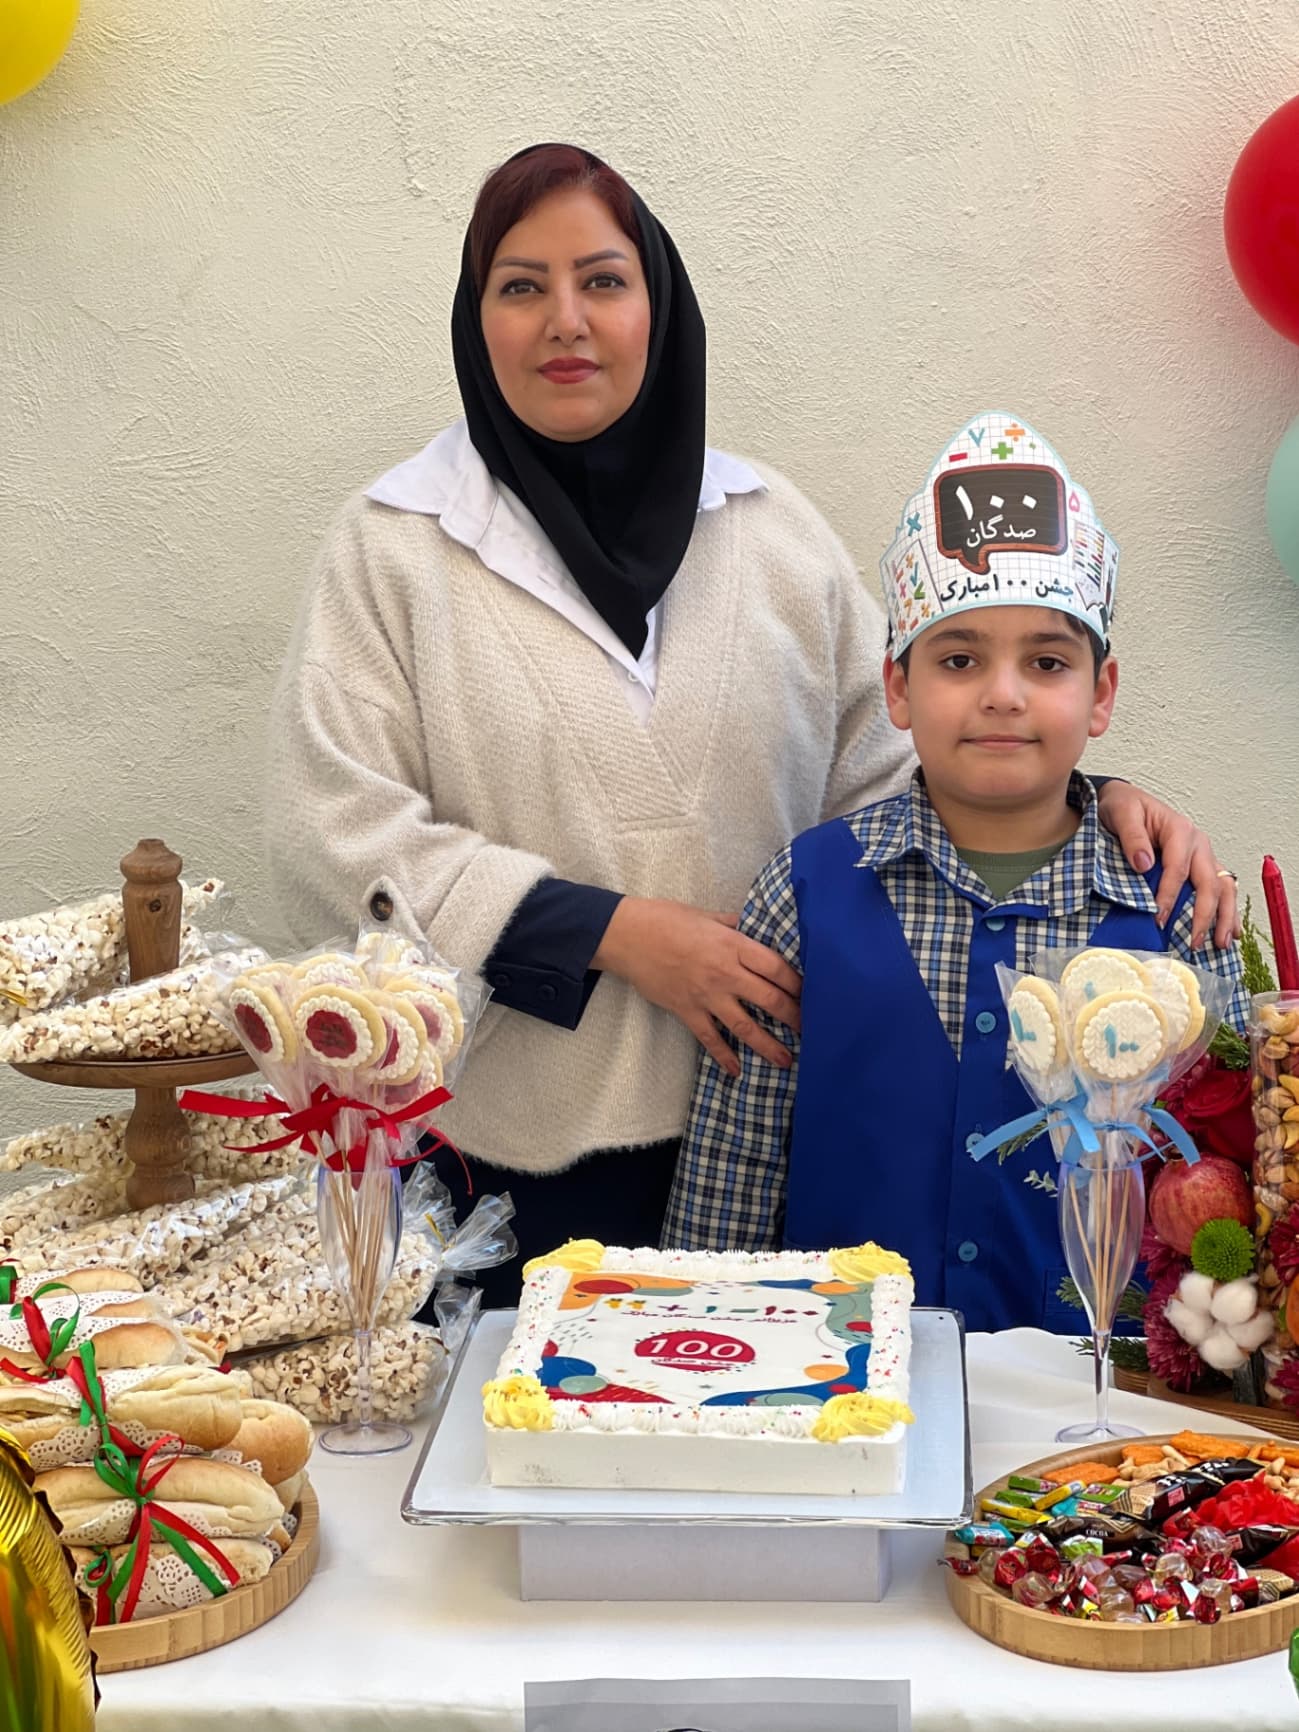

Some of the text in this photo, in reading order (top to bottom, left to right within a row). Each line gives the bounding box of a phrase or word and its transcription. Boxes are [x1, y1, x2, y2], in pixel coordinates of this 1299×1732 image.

[955, 485, 1037, 520] ۱۰۰
[966, 514, 1037, 548] صدگان
[1035, 578, 1074, 603] جشن
[650, 1338, 744, 1358] 100
